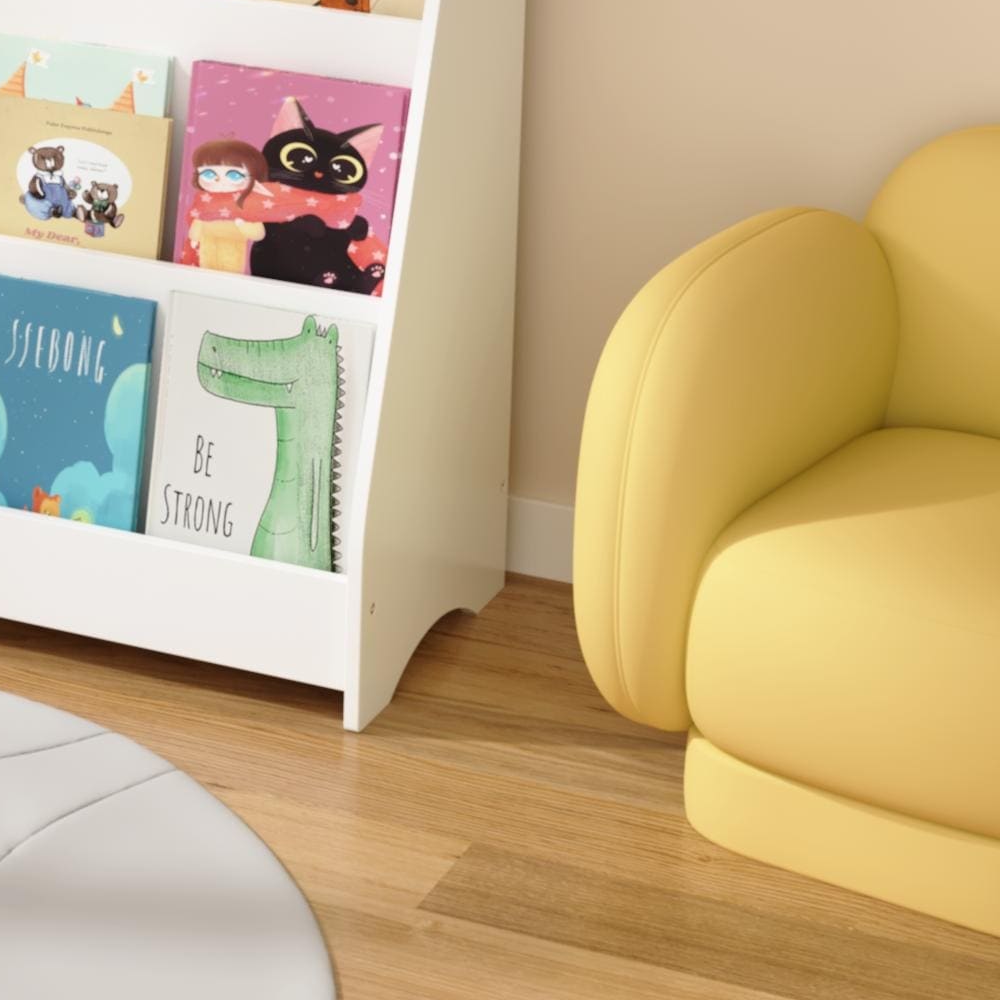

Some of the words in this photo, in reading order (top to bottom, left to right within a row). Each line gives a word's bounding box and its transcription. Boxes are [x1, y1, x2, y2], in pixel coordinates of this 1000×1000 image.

[24, 227, 45, 241] My
[4, 318, 106, 385] SSEBONG
[193, 434, 215, 478] BE
[160, 483, 234, 538] STRONG
